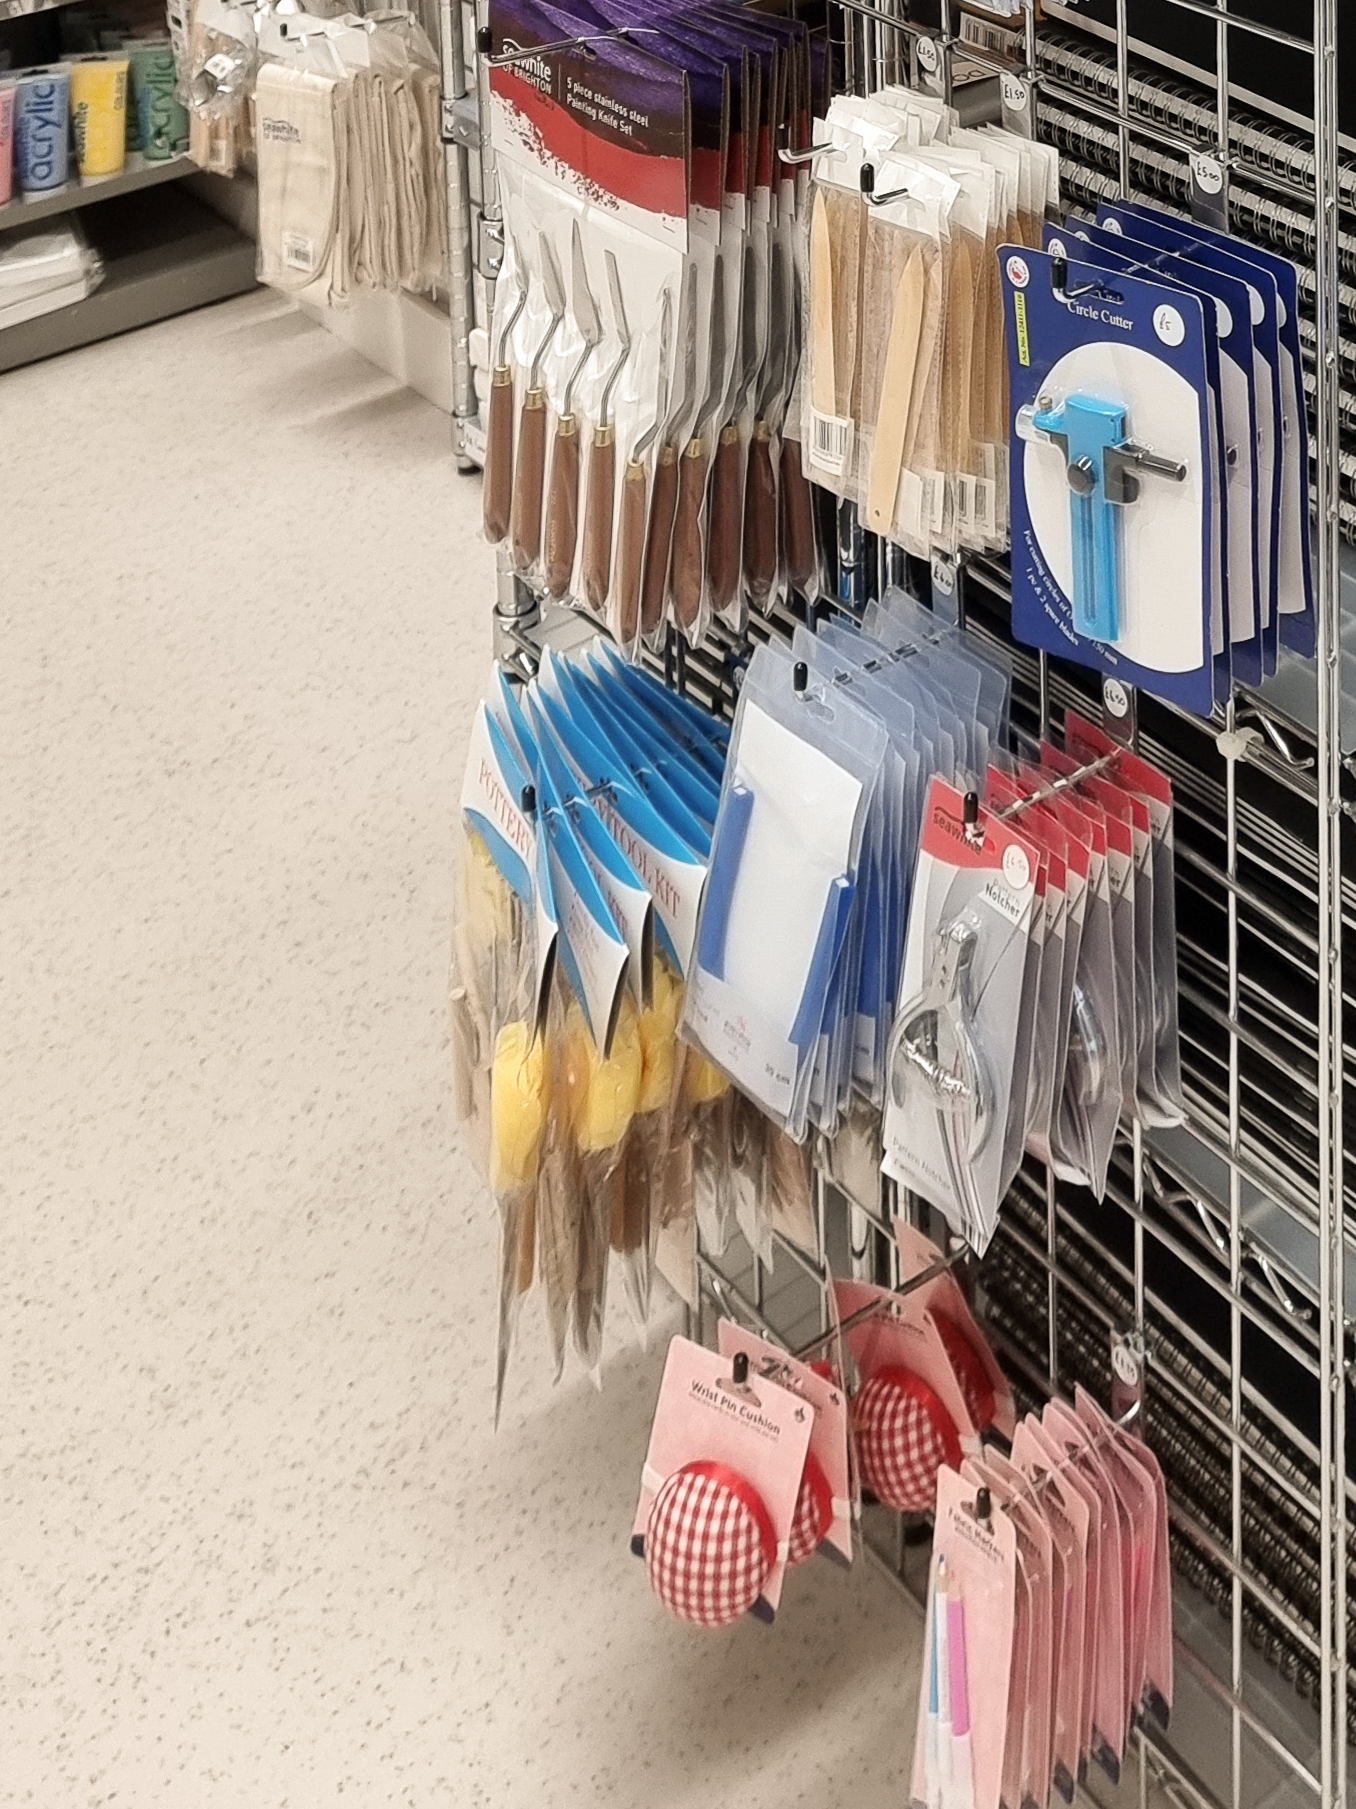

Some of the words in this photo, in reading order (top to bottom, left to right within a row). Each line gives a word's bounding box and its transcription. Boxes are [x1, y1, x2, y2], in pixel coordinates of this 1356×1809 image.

[918, 42, 935, 62] £1.50
[567, 76, 572, 89] 5
[573, 81, 593, 100] piece
[594, 91, 628, 117] stainless
[629, 110, 649, 128] steel
[1004, 84, 1025, 100] £1.50
[26, 82, 62, 182] acrylic
[566, 93, 597, 121] Painting
[599, 109, 618, 129] Knife
[619, 120, 633, 136] Set
[1196, 160, 1221, 182] £5.00
[1067, 299, 1099, 321] Circle
[1100, 309, 1134, 331] Cutter
[478, 759, 533, 860] POTTERY
[612, 813, 652, 884] TOOL
[653, 866, 681, 919] KIT
[985, 882, 1021, 918] Notcher
[691, 1379, 719, 1403] Wrist
[720, 1395, 737, 1413] Pin
[739, 1405, 781, 1435] Cushion
